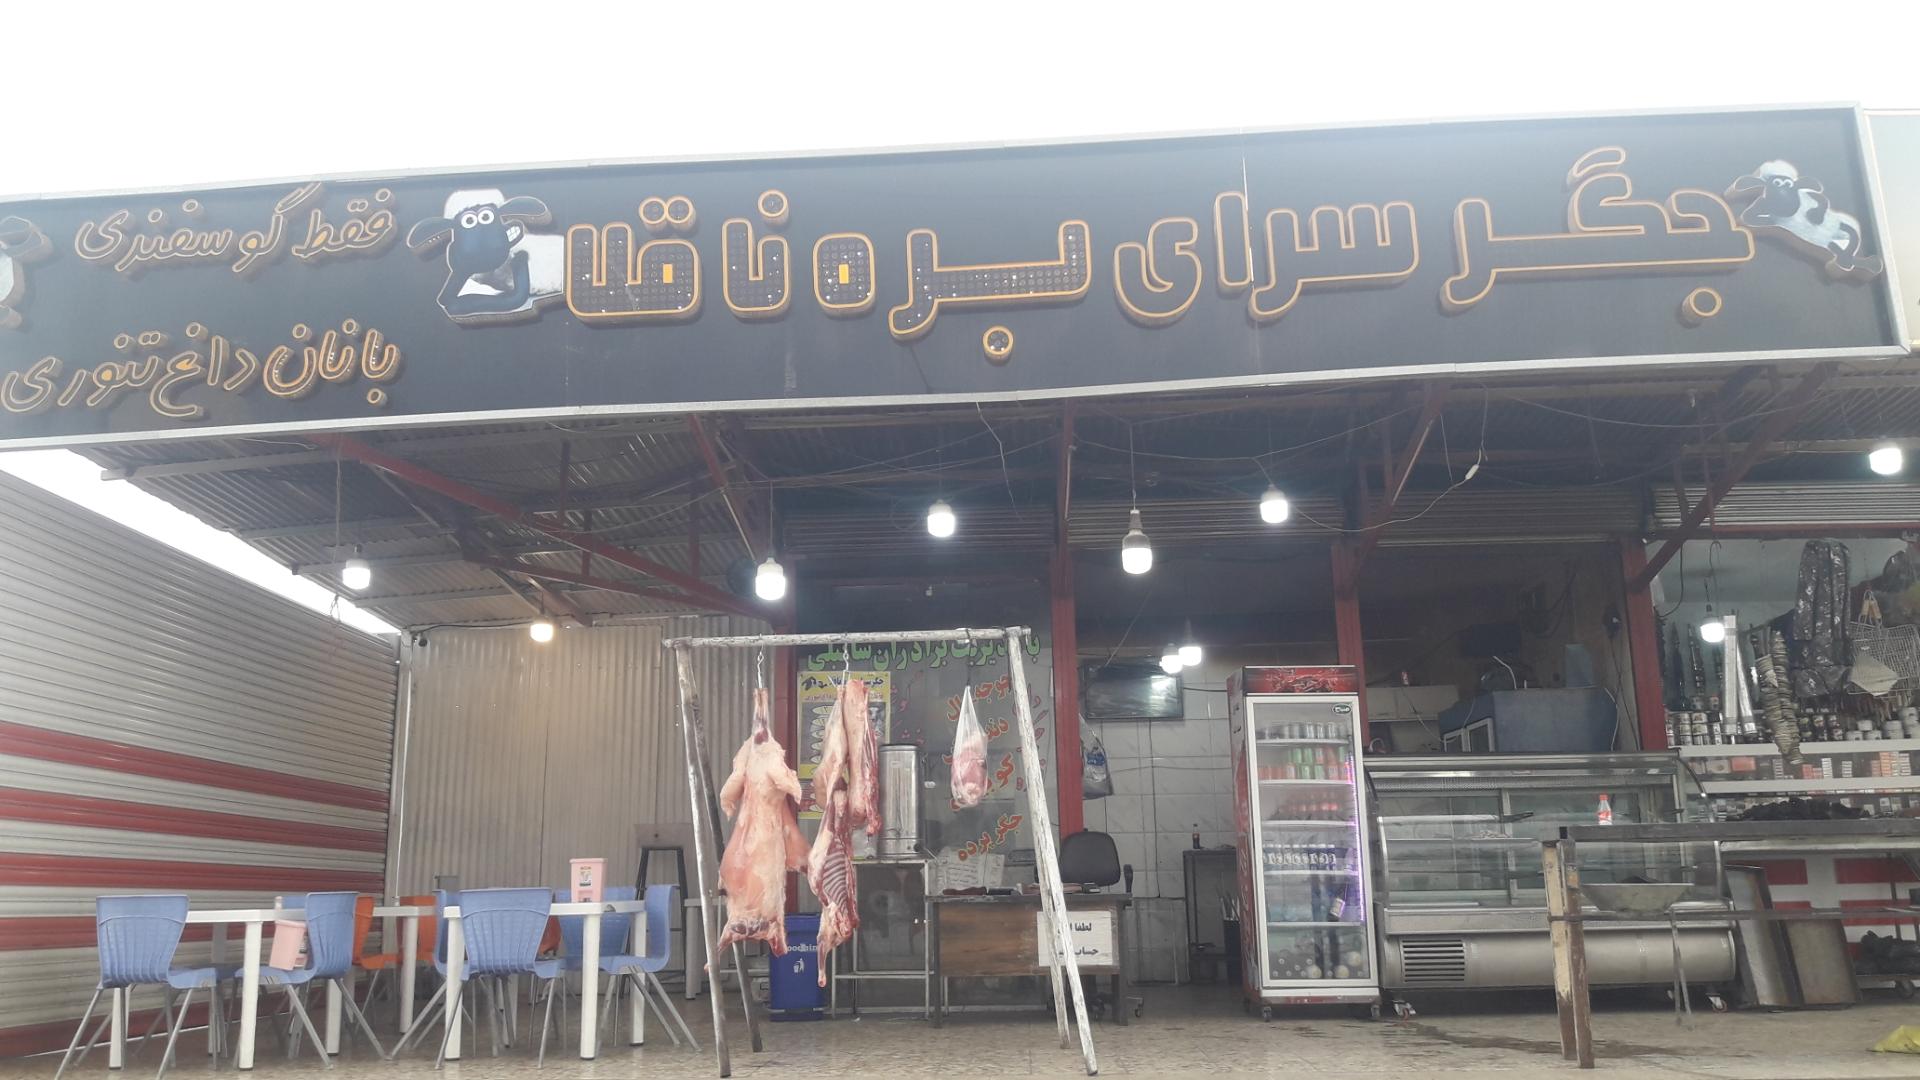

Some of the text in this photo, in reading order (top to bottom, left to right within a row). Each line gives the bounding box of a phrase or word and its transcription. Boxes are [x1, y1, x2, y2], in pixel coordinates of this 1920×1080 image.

[291, 187, 399, 260] فقط
[565, 146, 1757, 362] جگر سرای بره ناقلا
[0, 318, 401, 419] با نان داغ تنوری
